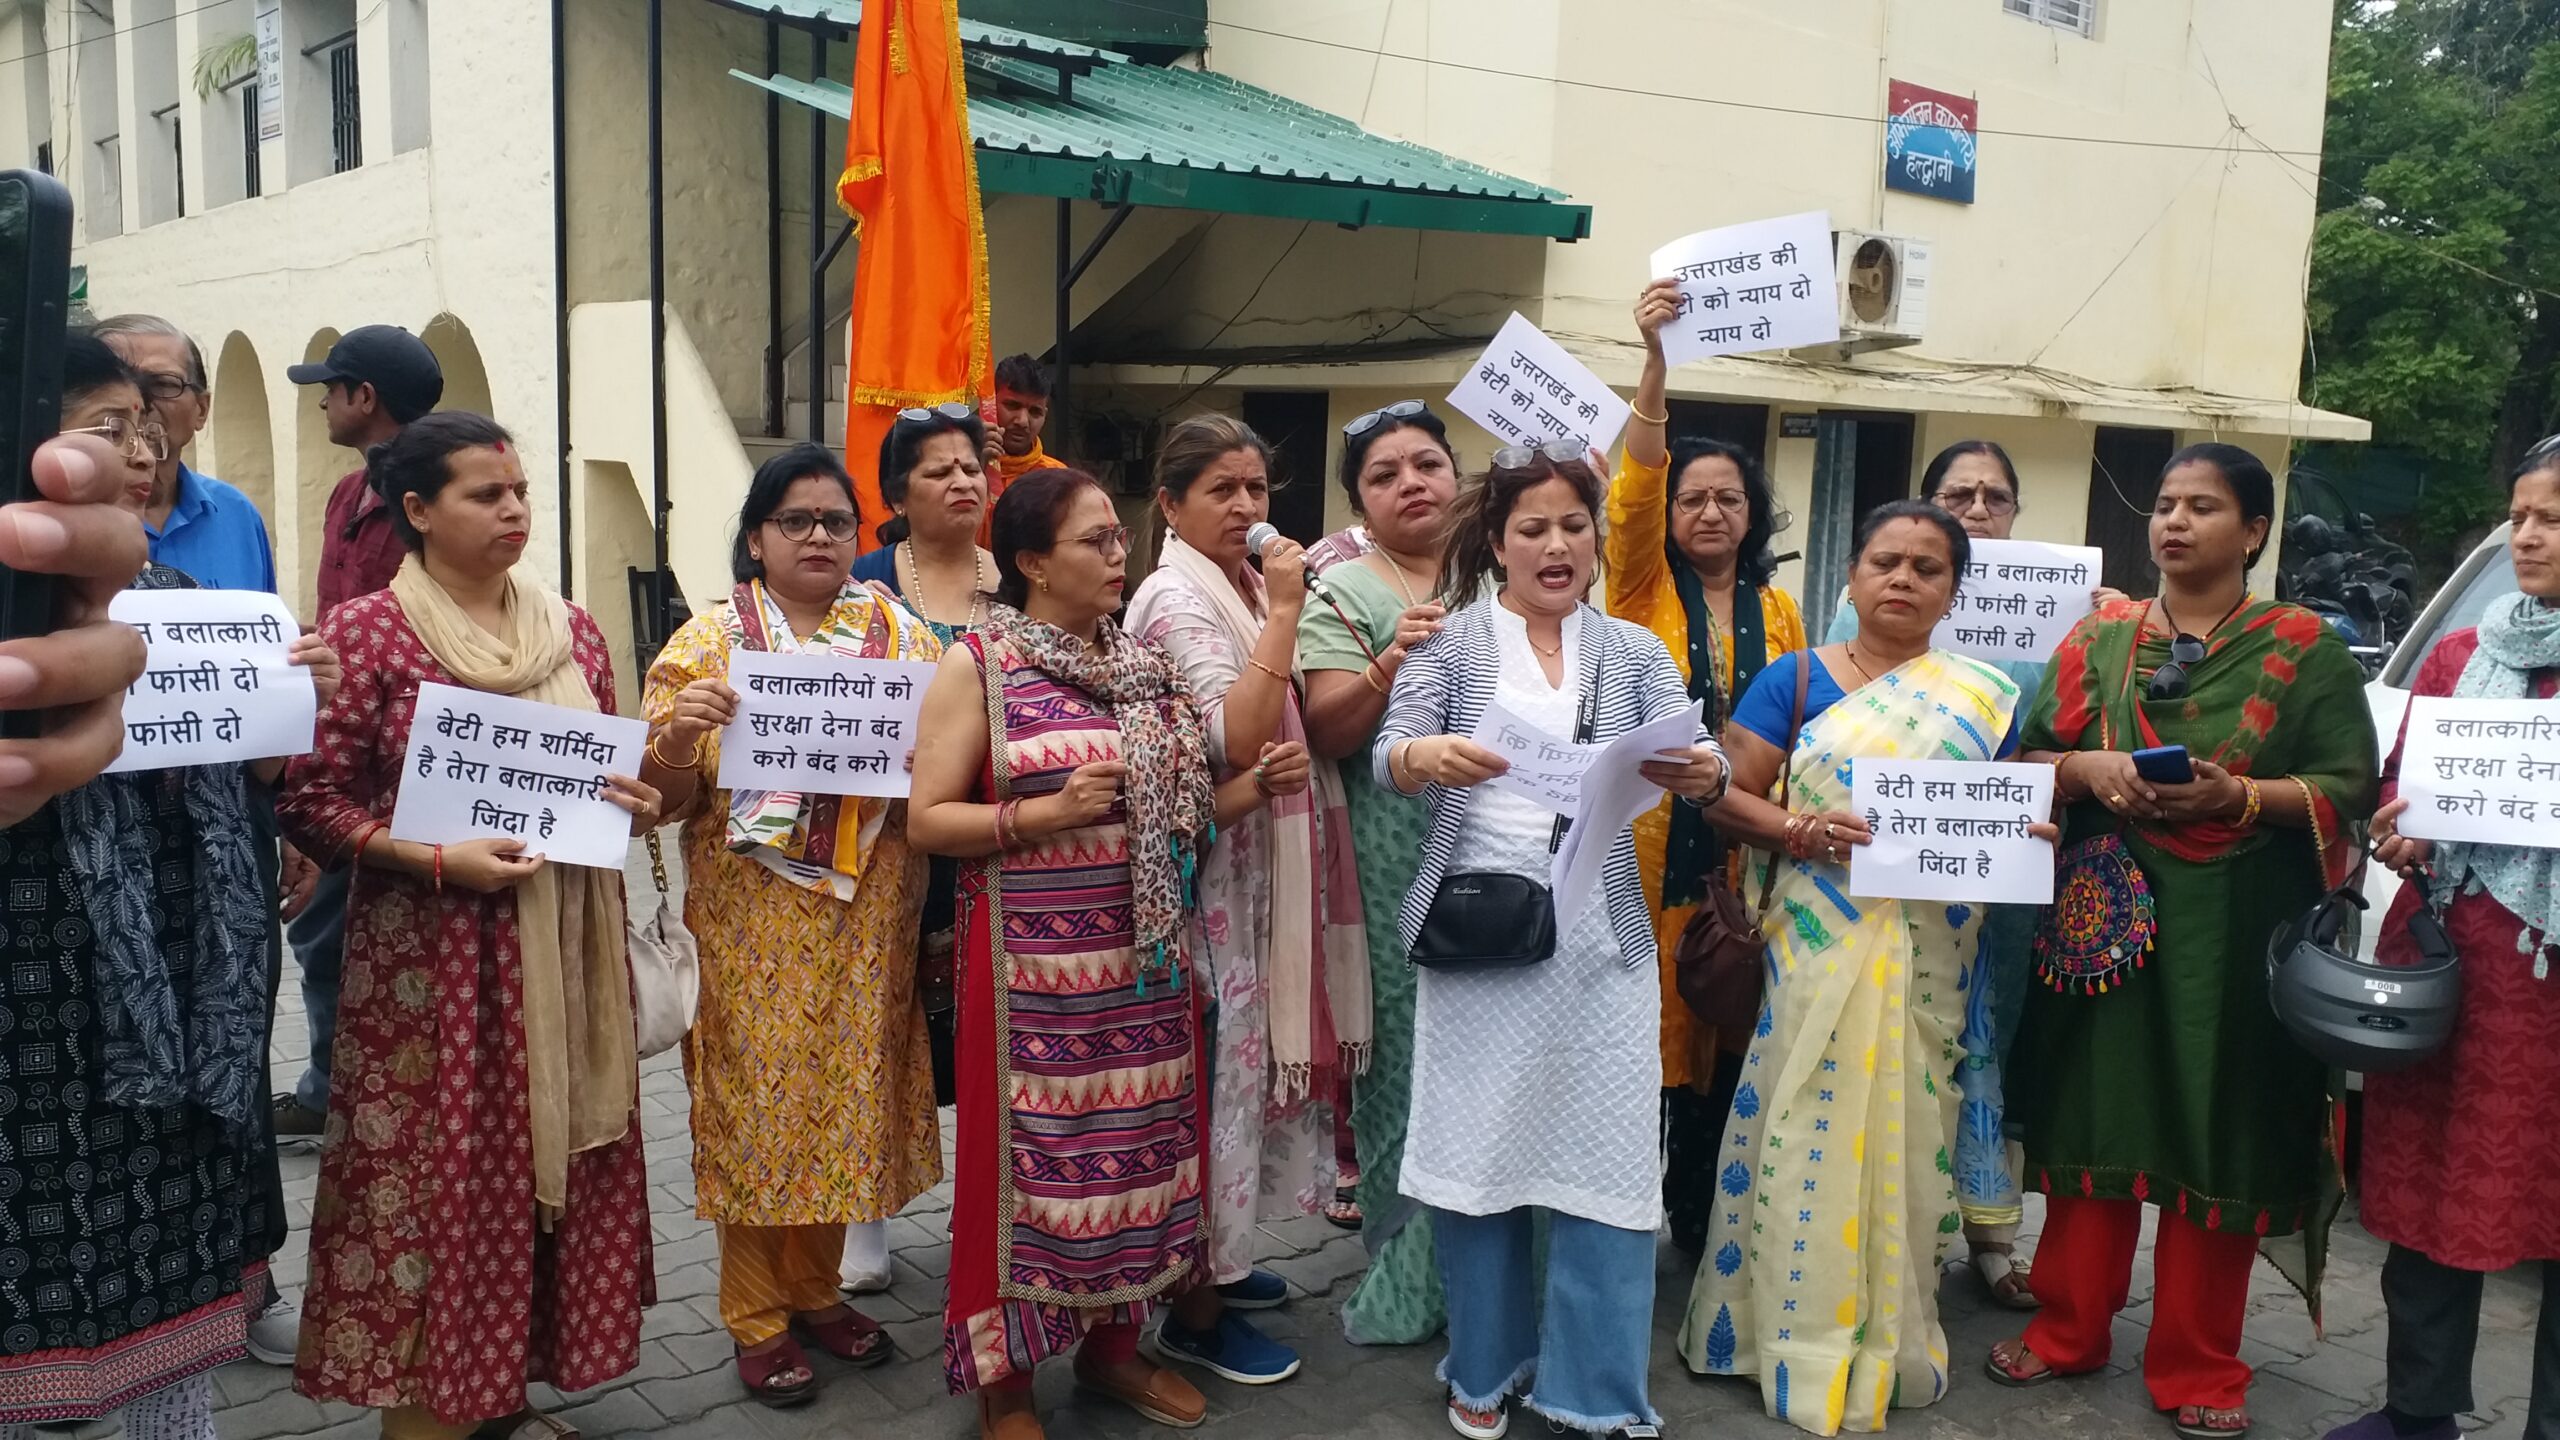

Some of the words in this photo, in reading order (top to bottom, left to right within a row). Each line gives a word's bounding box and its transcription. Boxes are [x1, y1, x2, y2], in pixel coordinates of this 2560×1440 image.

[1906, 150, 1954, 187] हल्द्वानी
[1672, 251, 1762, 283] उत्तराखंड
[1770, 242, 1798, 267] की
[1676, 292, 1695, 320] टी
[1702, 286, 1730, 311] को
[1737, 284, 1782, 305] न्याय
[1789, 274, 1812, 300] दो
[1697, 325, 1743, 344] न्याय
[1750, 316, 1772, 341] दो
[1480, 362, 1511, 394] बेटी
[1511, 388, 1535, 413] को
[1536, 406, 1571, 440] न्याय
[1510, 350, 1577, 407] उत्तराखंड
[1577, 400, 1600, 425] की
[1487, 408, 1523, 438] न्याय
[1963, 562, 1990, 580] न
[1997, 563, 2089, 586] बलात्कारी
[1974, 593, 2028, 616] फांसी
[2035, 594, 2057, 619] दो
[129, 622, 154, 645] न
[162, 614, 283, 645] बलात्कारी
[1954, 625, 2007, 647] फांसी
[2014, 626, 2036, 650] दो
[147, 659, 220, 694] फांसी
[230, 658, 259, 693] दो
[748, 672, 876, 700] बलात्कारियों
[883, 675, 913, 701] को
[128, 711, 203, 747] फांसी
[212, 708, 242, 743] दो
[436, 707, 483, 742] बेटी
[492, 724, 531, 750] हम
[540, 730, 617, 765] शर्मिंदा
[749, 712, 813, 737] सुरक्षा
[821, 710, 862, 738] देना
[870, 715, 903, 741] बंद
[2435, 715, 2560, 741] बलात्कारि
[417, 745, 437, 778] है
[446, 750, 489, 784] तेरा
[498, 766, 612, 802] बलात्कारी
[752, 745, 798, 769] करो
[806, 749, 839, 774] बंद
[847, 750, 891, 775] करो
[2434, 756, 2507, 780] सुरक्षा
[1875, 773, 1914, 799] बेटी
[1923, 781, 1956, 802] हम
[1964, 777, 2034, 805] शर्मिंदा
[471, 799, 529, 834] जिंदा
[538, 807, 558, 839] है
[2435, 789, 2488, 817] करो
[2498, 794, 2539, 823] बंद
[1865, 807, 1882, 836] है
[1890, 809, 1927, 835] तेरा
[1935, 814, 2035, 840] बलात्कारी
[1918, 848, 1967, 877] जिंदा
[1975, 849, 1992, 878] है
